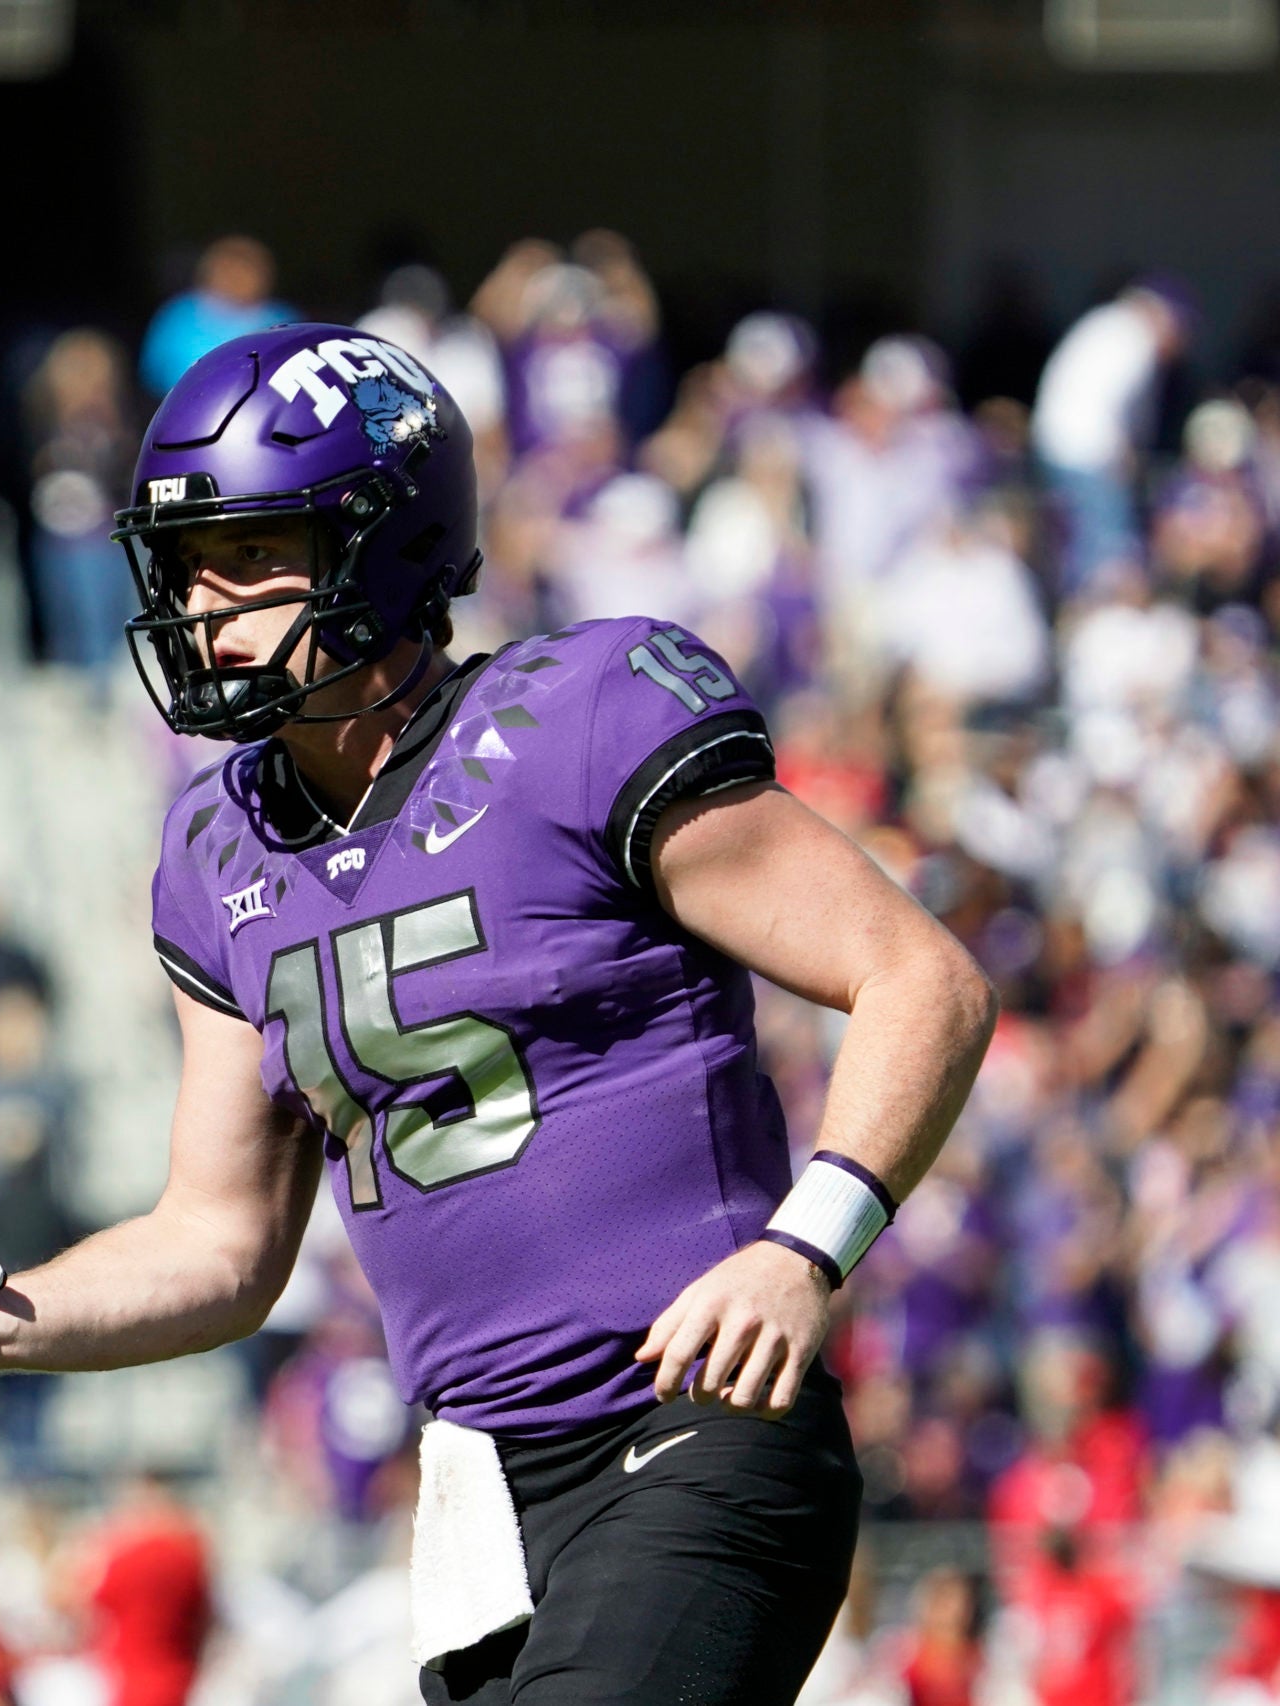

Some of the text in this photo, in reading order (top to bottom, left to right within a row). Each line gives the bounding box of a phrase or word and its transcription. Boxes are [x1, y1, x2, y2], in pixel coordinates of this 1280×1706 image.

[268, 338, 434, 429] TCU
[148, 477, 187, 503] TCU
[626, 627, 738, 716] 15
[326, 847, 367, 880] TCU
[221, 877, 270, 933] XII
[264, 886, 542, 1212] 15
